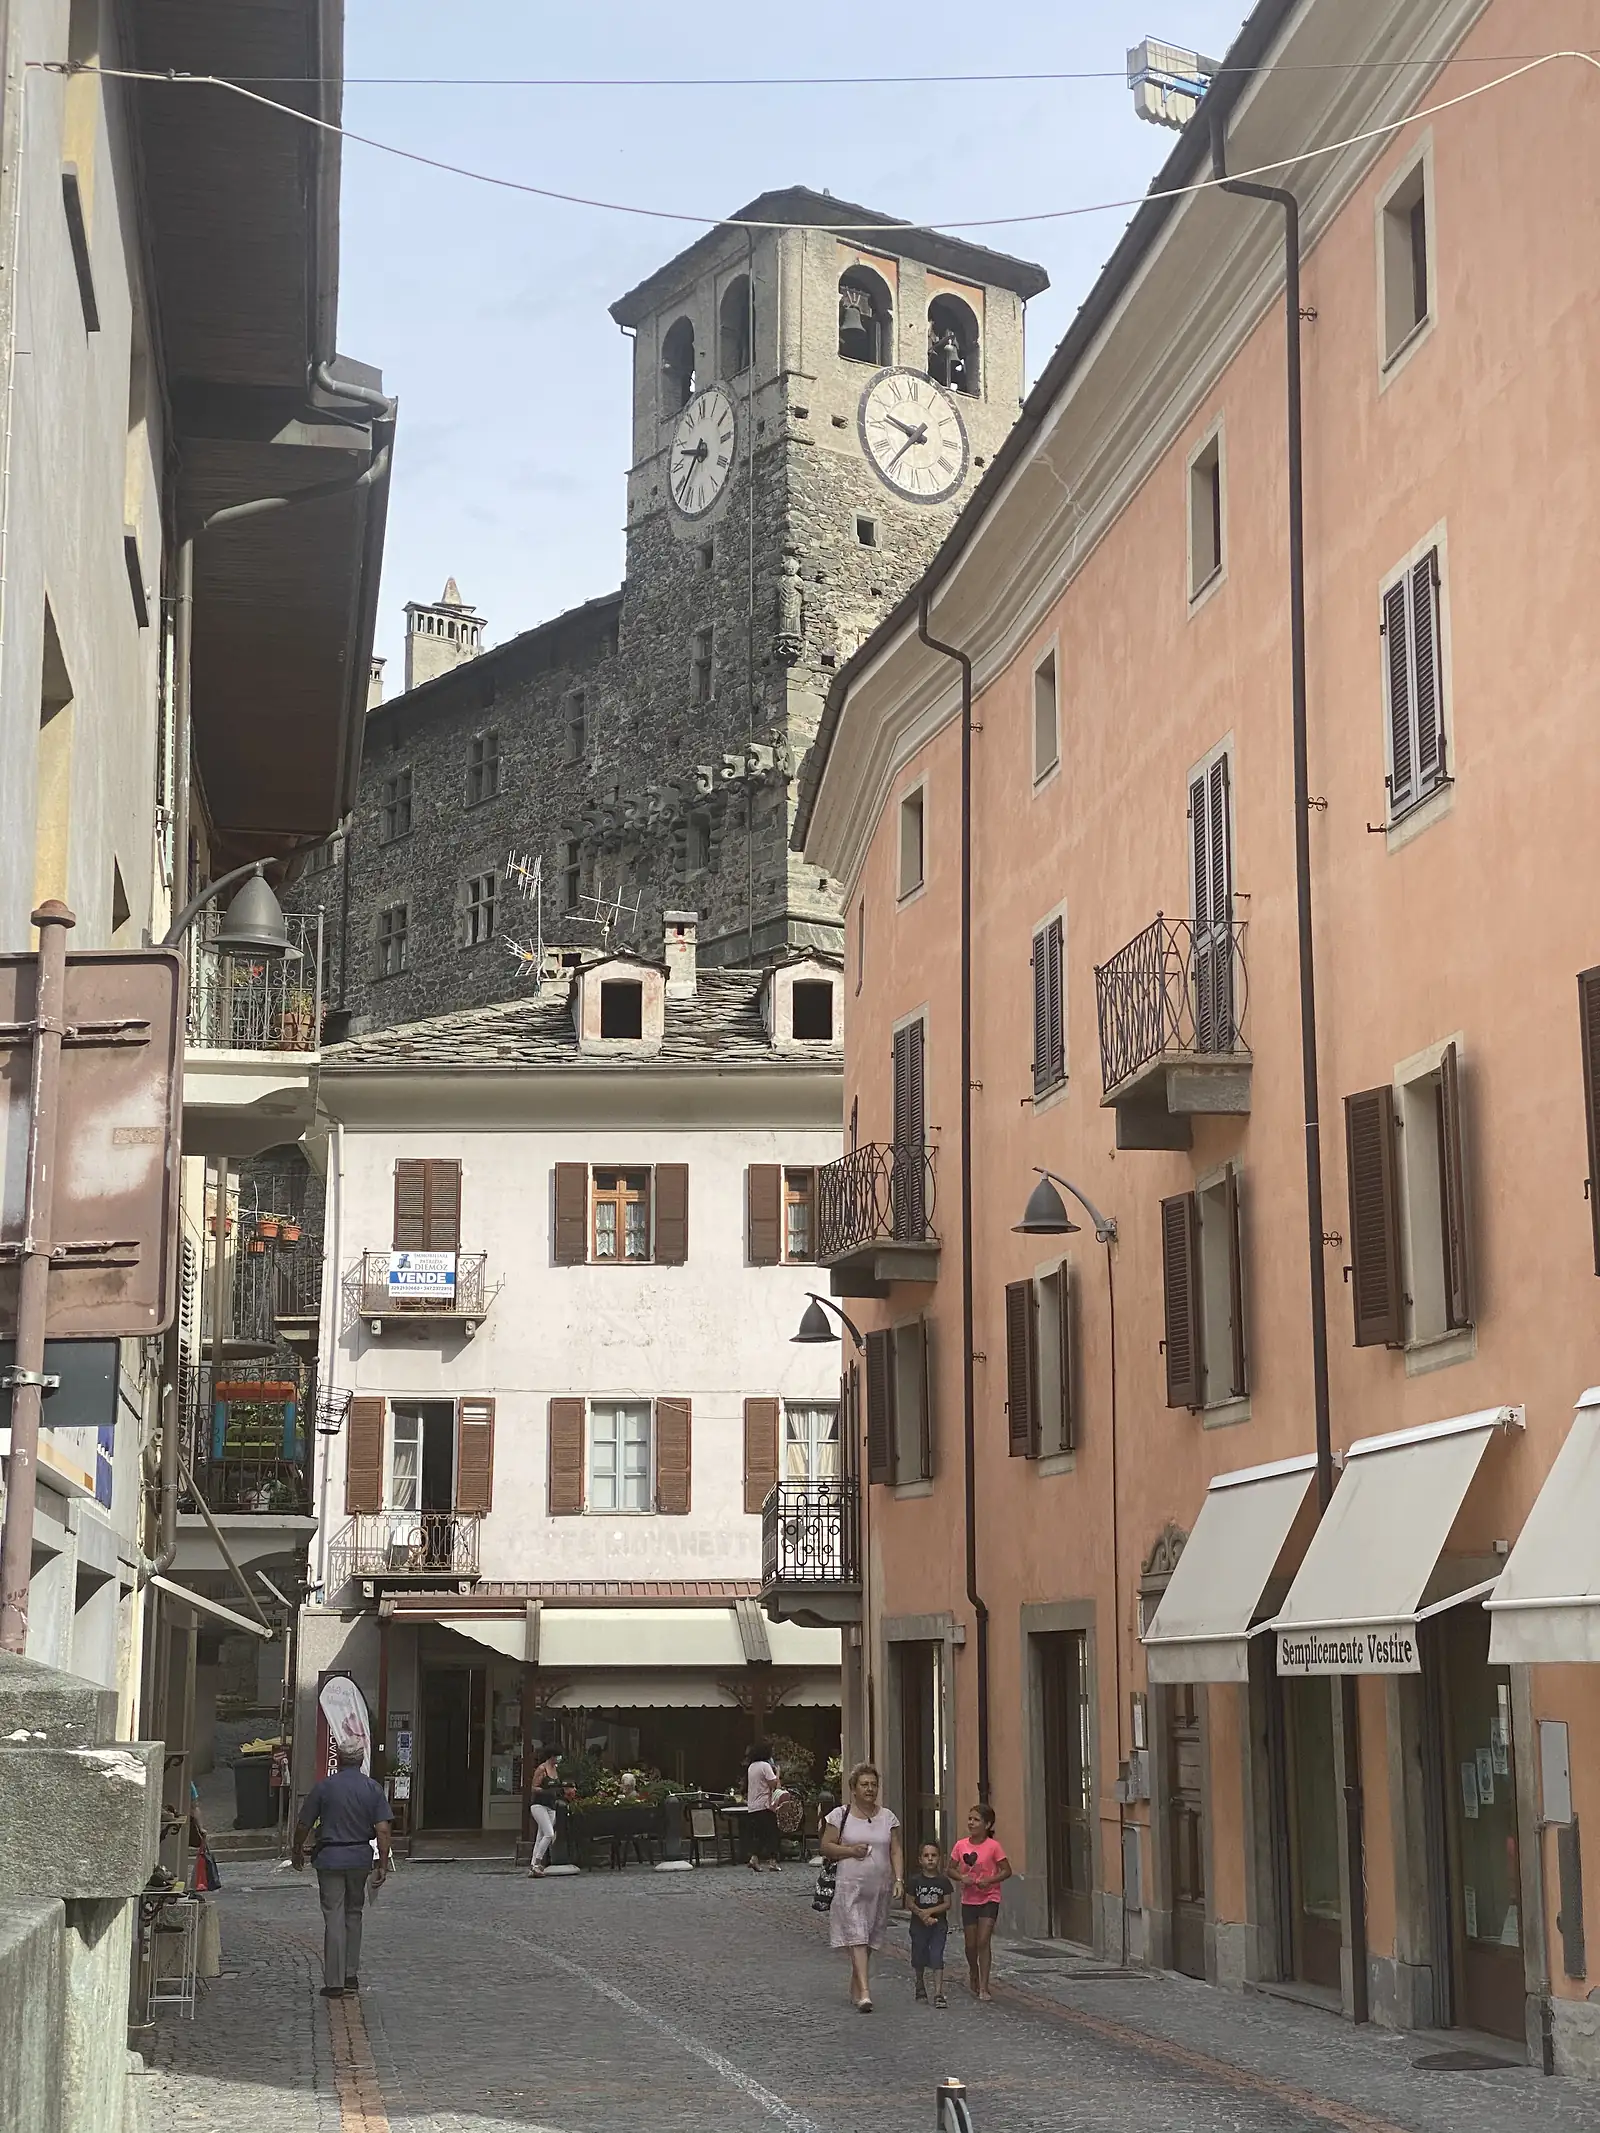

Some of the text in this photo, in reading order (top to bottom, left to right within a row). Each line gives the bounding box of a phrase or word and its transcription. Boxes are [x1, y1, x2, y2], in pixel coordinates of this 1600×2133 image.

[397, 1272, 447, 1284] VENDE
[1282, 1632, 1412, 1672] Semplicemente Vestire
